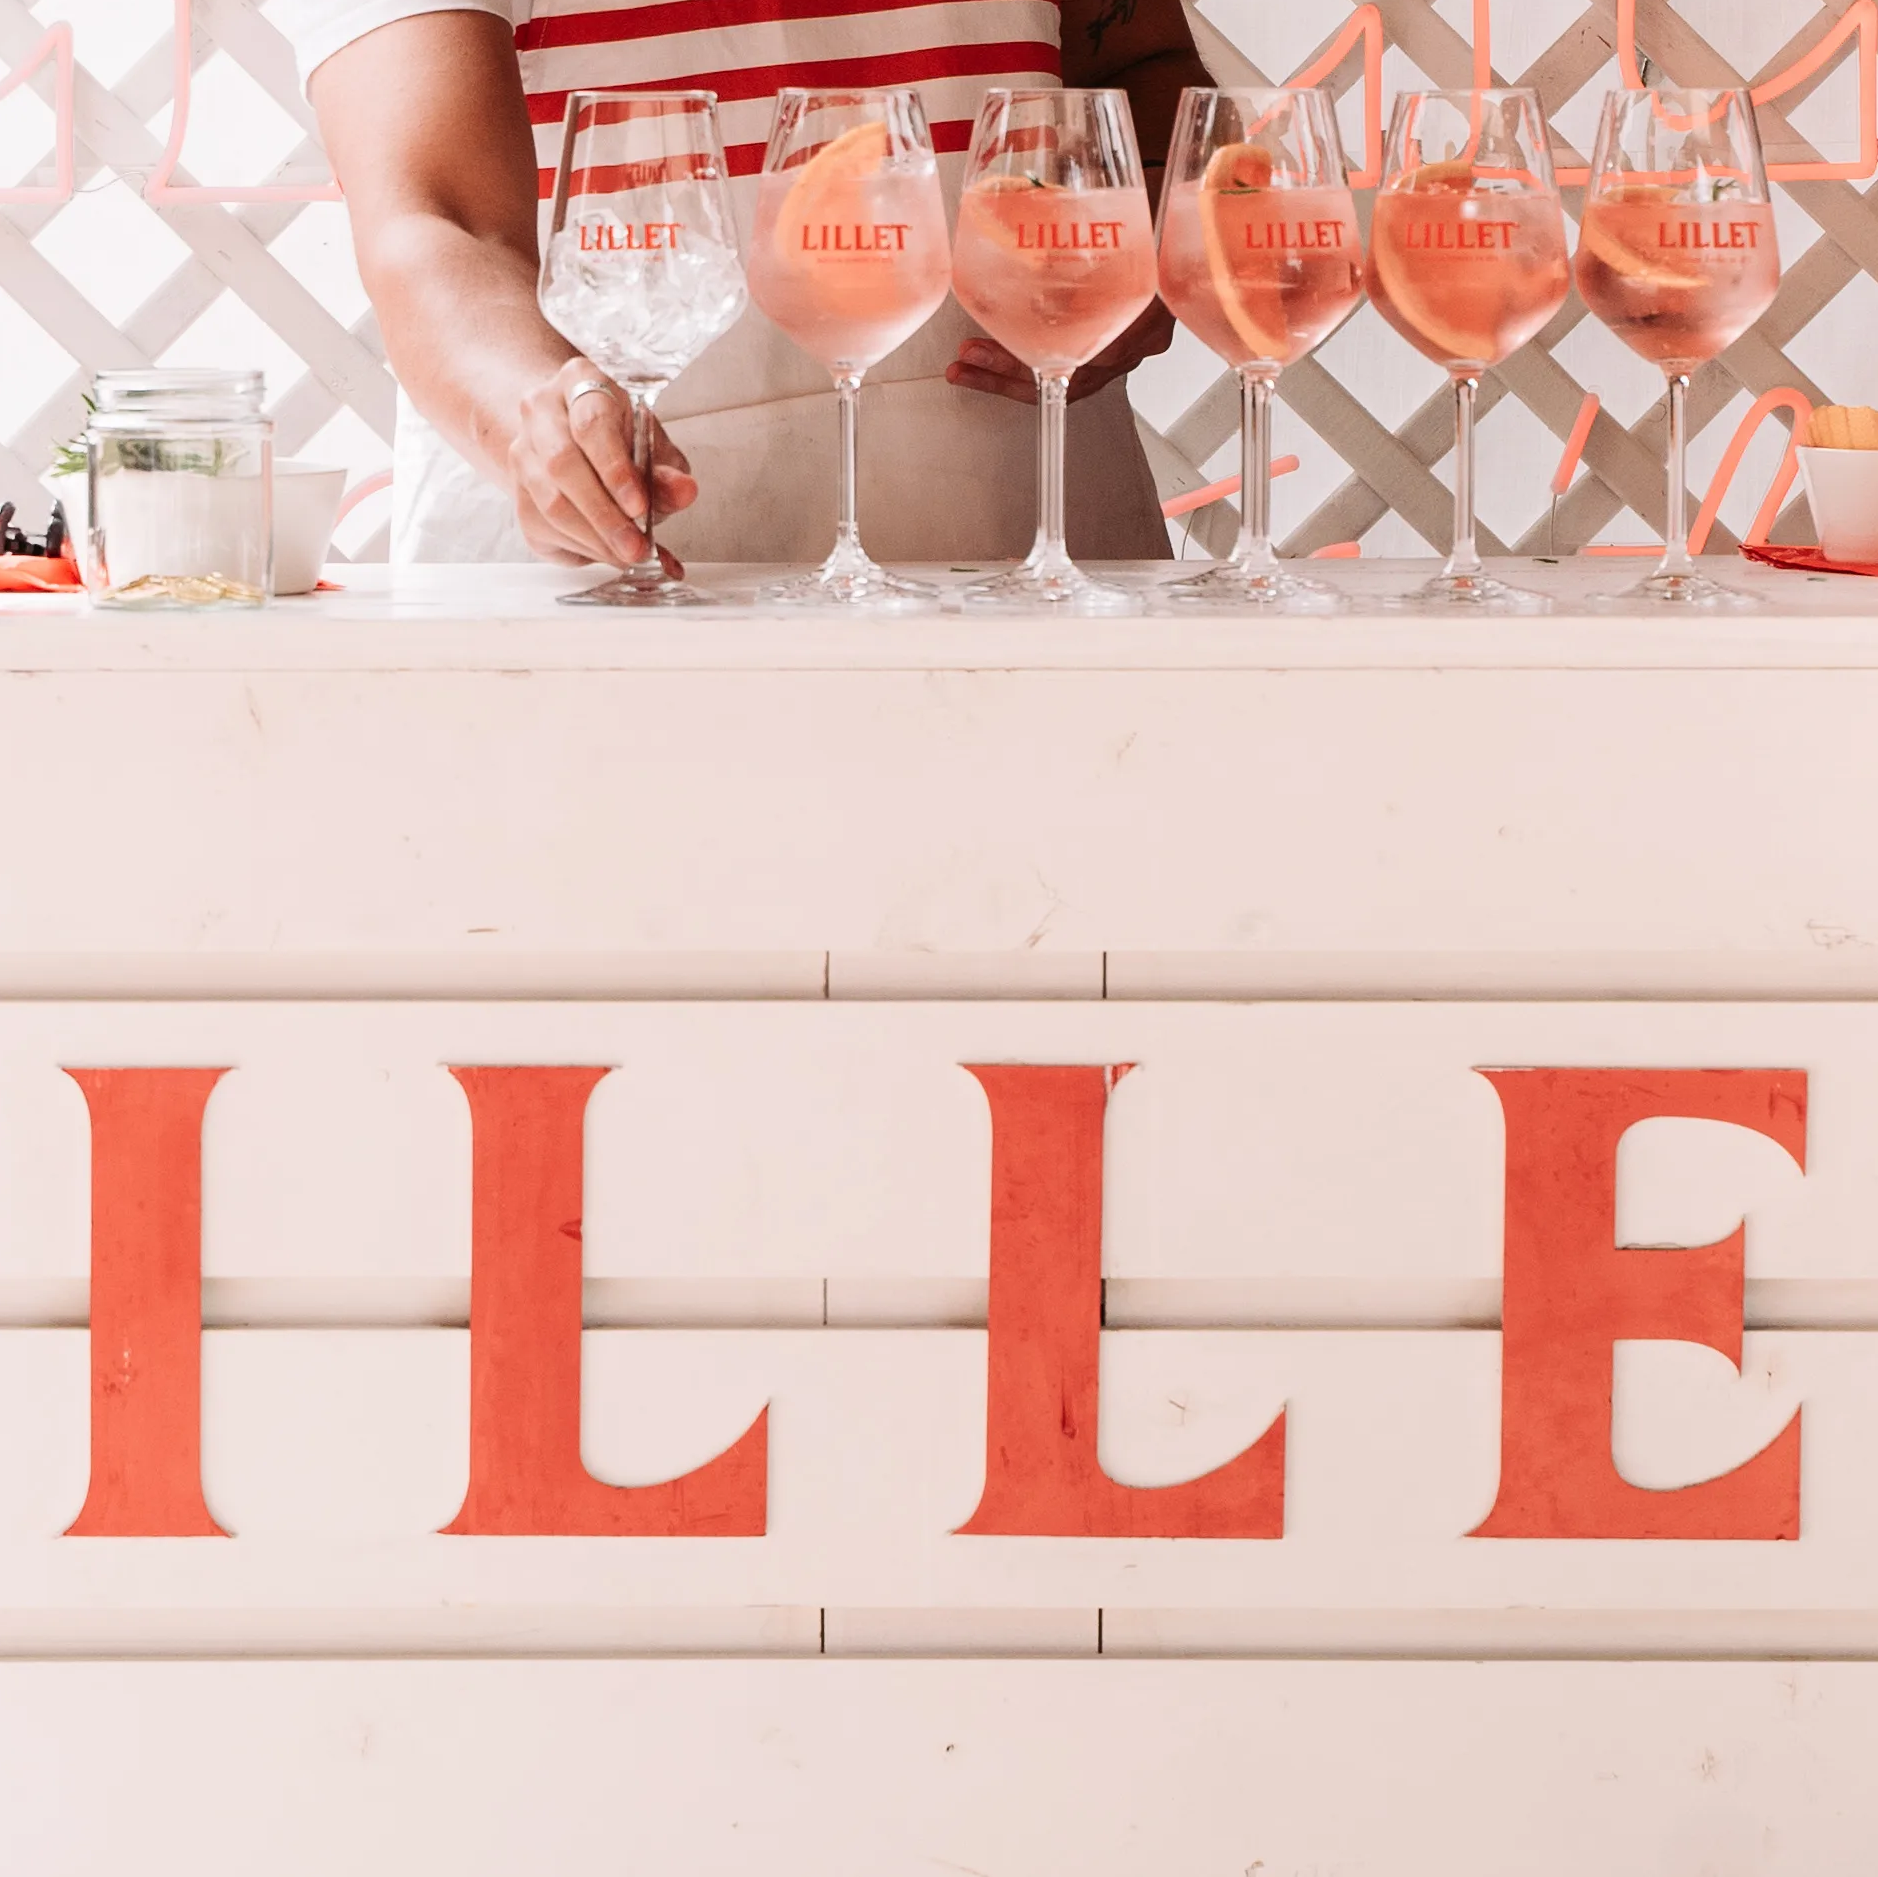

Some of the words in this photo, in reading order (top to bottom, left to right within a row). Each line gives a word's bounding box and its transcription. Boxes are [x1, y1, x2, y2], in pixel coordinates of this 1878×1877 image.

[580, 223, 681, 251] LILLET
[801, 224, 908, 251] LILLET
[1017, 222, 1122, 249] LILLET
[1245, 221, 1344, 249] LILLET
[1405, 222, 1516, 249] LILLET
[1658, 221, 1760, 248] LILLET
